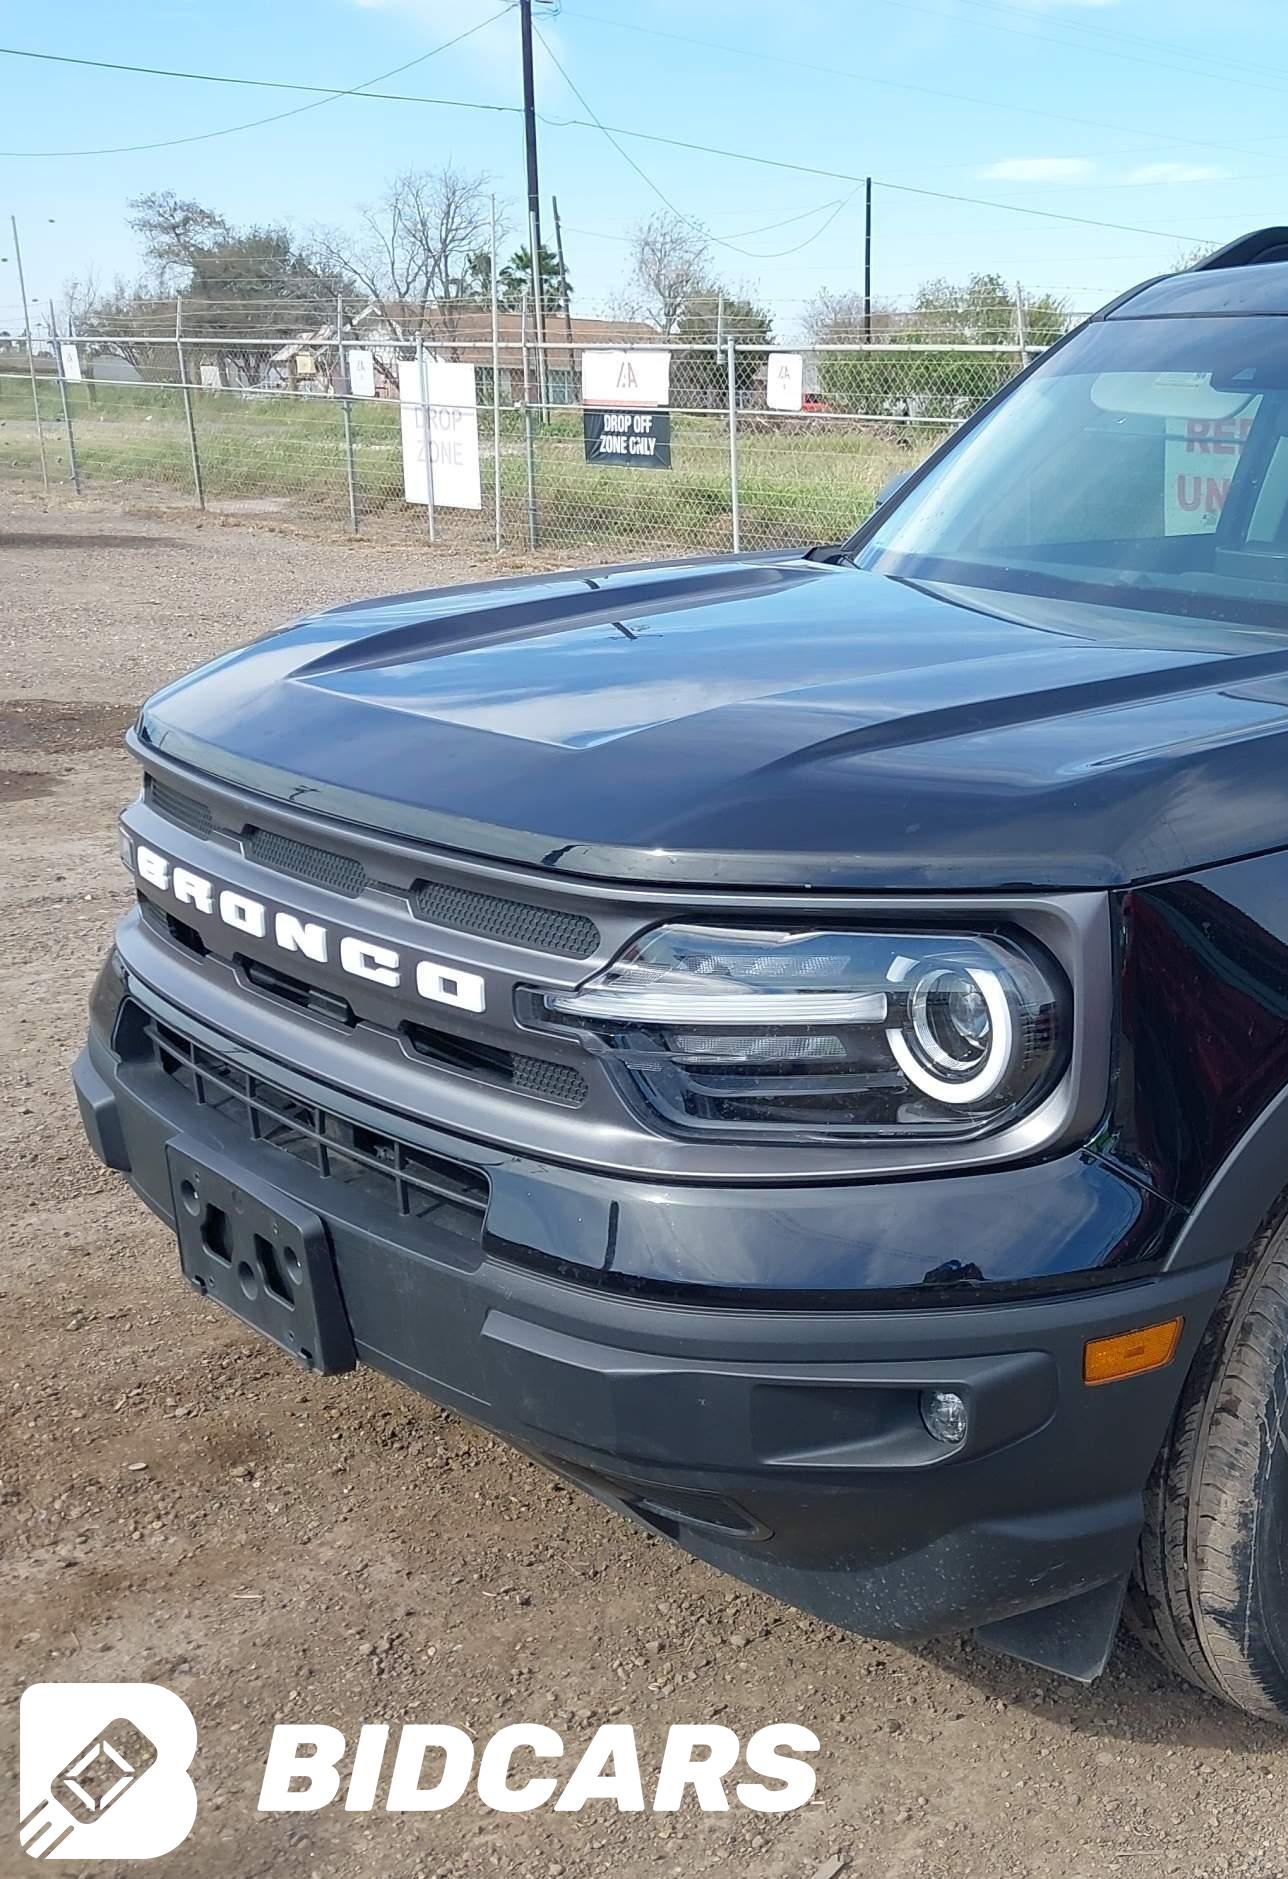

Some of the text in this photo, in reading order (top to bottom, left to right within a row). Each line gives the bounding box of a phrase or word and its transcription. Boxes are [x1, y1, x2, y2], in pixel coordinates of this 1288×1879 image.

[604, 414, 653, 434] DROP OFF
[600, 435, 657, 456] ZONE ONLY
[136, 845, 486, 1014] BRONCO
